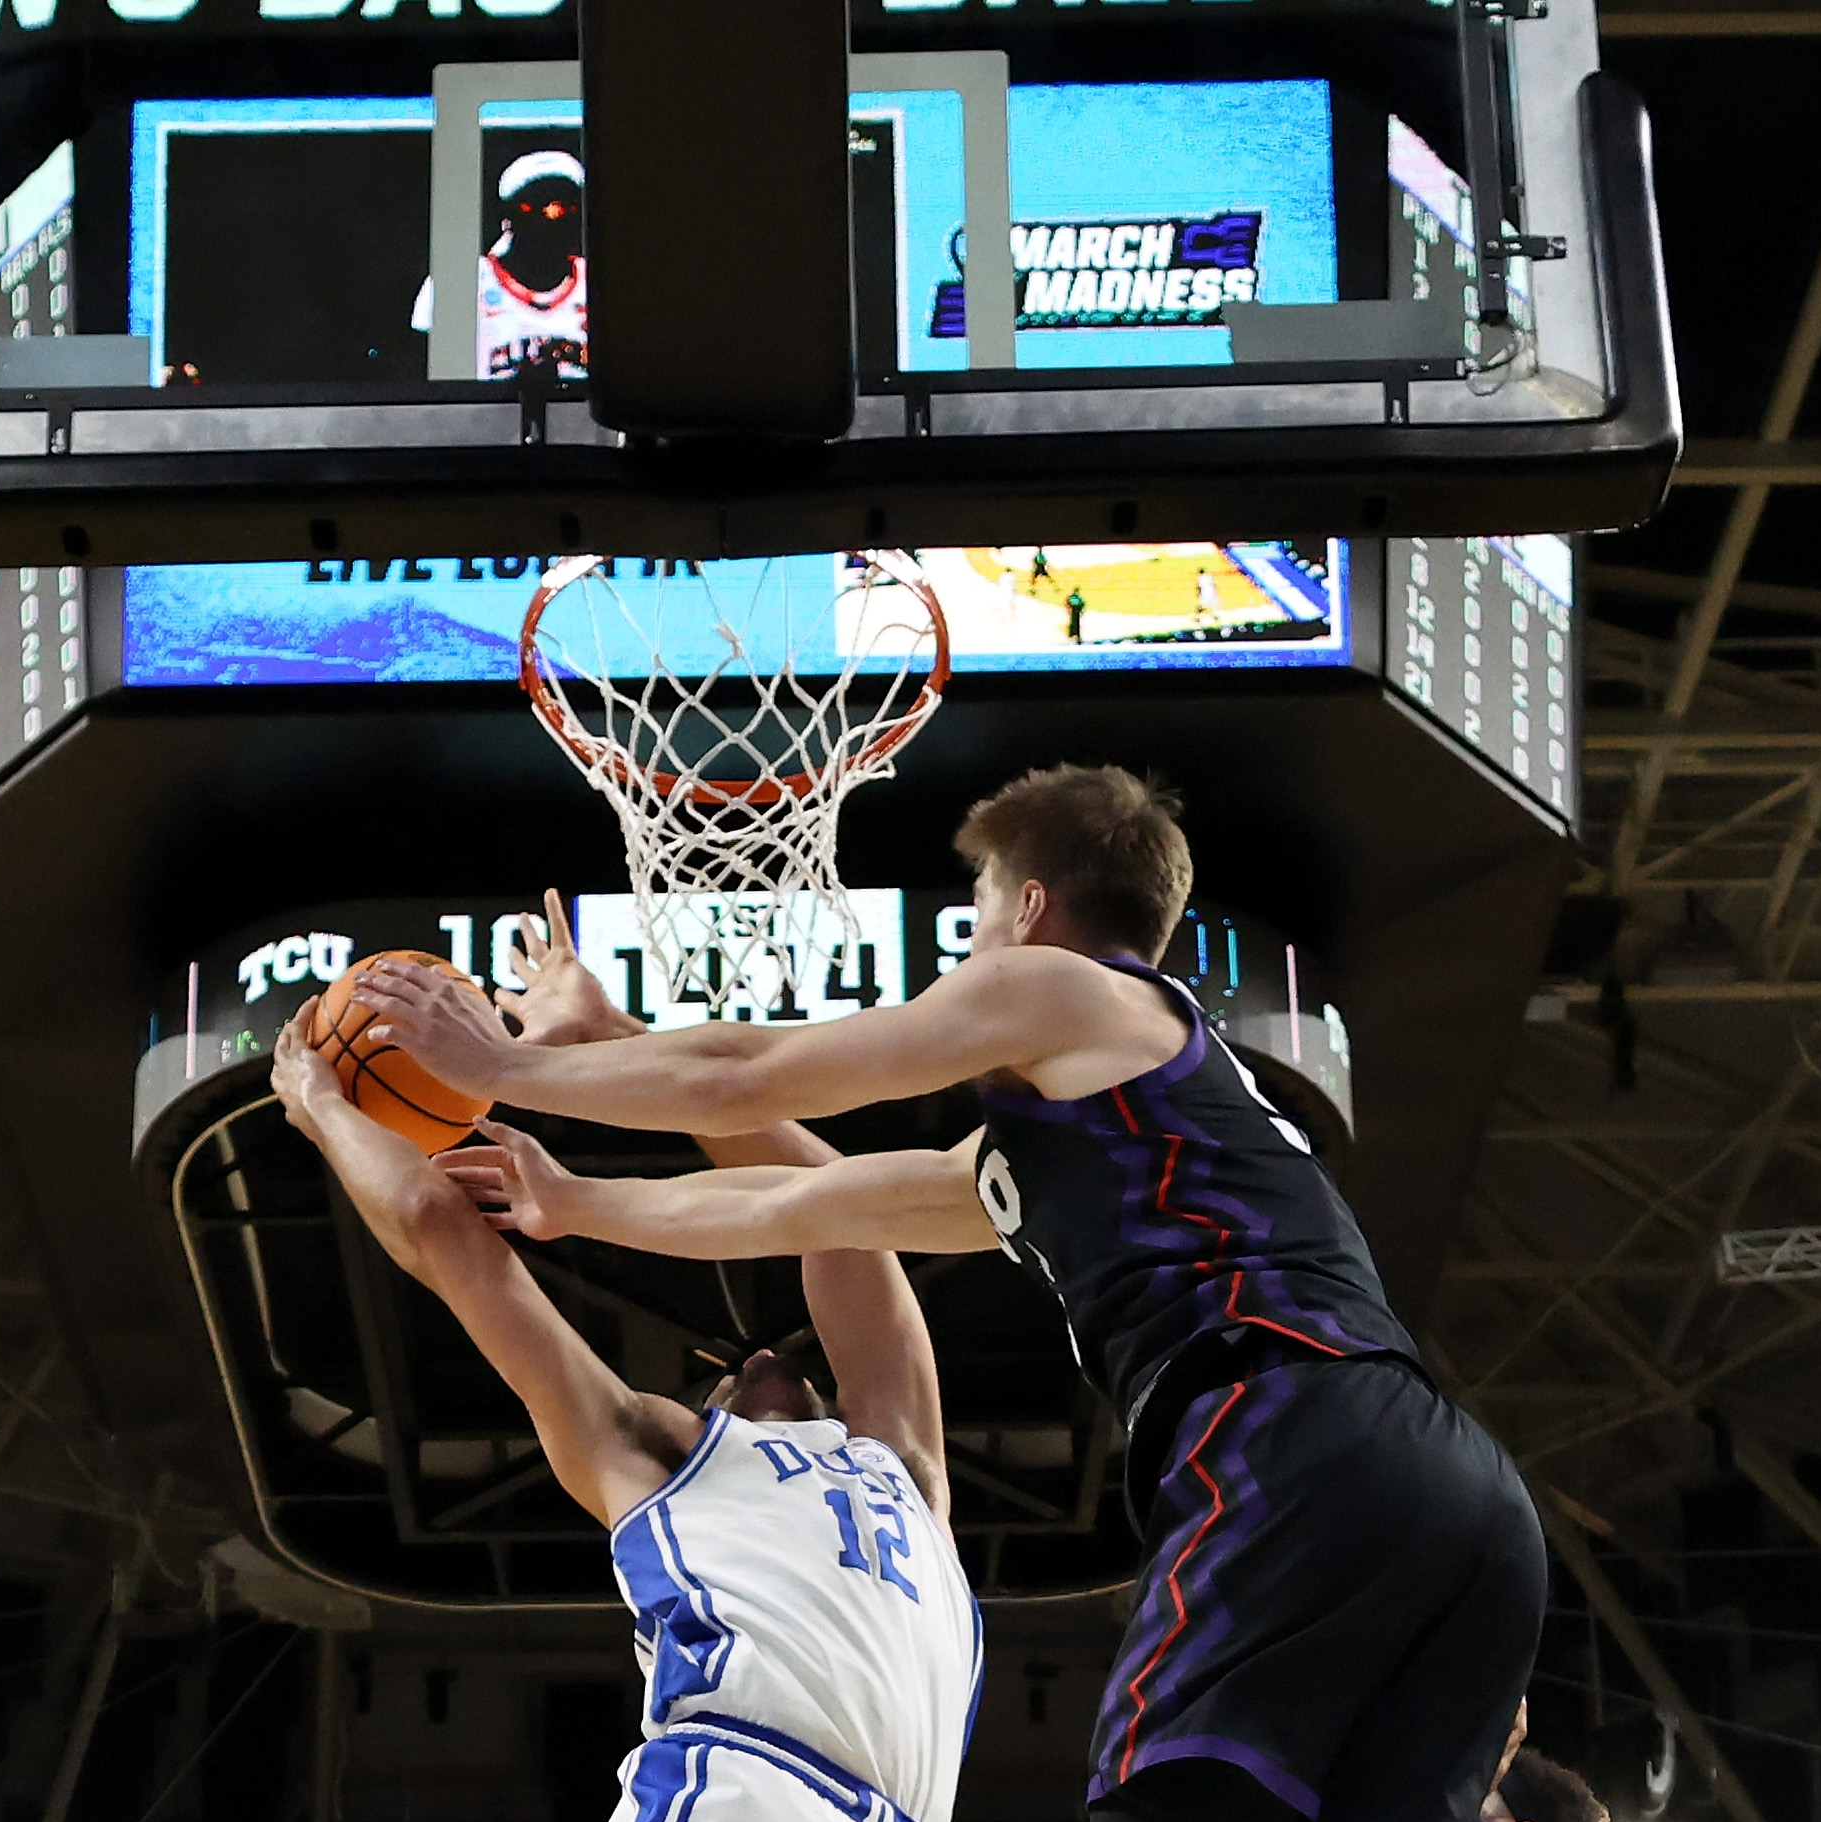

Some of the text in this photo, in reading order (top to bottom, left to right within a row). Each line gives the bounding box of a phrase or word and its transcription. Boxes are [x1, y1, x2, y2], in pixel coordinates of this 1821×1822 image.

[1010, 224, 1176, 268] MARCH
[1023, 267, 1258, 313] MADNESS
[238, 932, 355, 1004] TCU
[614, 943, 882, 1023] 14:14
[824, 1488, 920, 1604] 12
